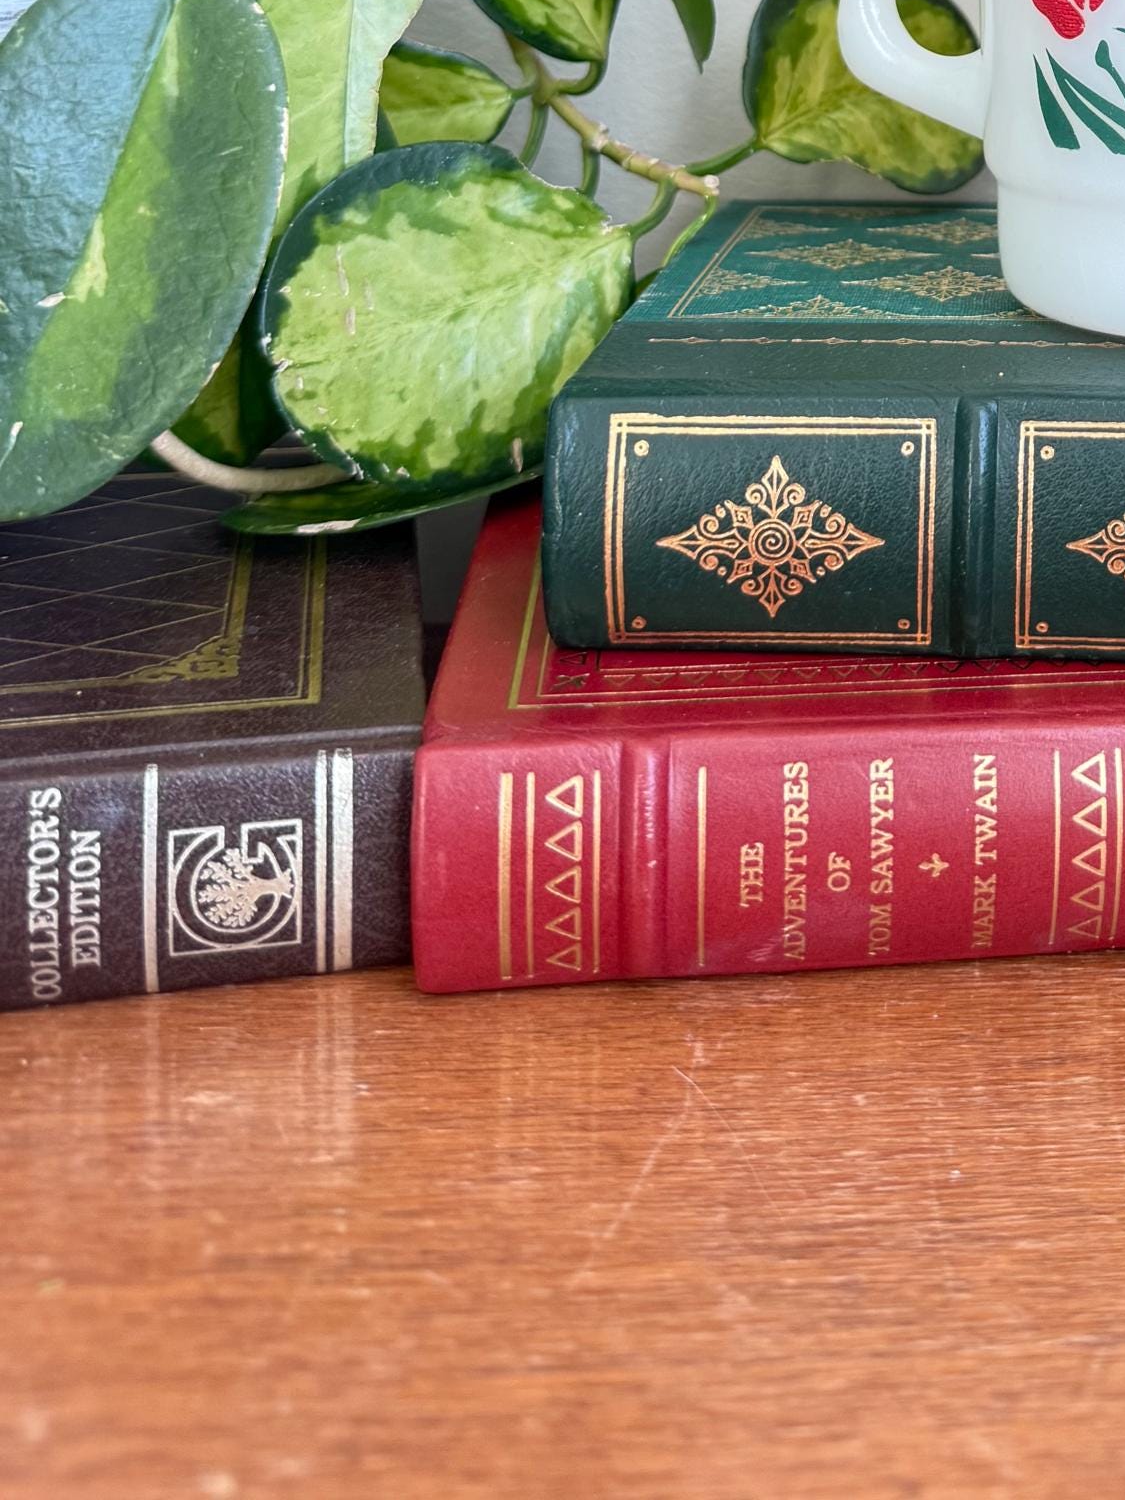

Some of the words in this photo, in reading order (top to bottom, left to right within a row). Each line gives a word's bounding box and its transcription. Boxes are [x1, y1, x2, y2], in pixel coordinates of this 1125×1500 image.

[783, 760, 809, 961] ADVENTURES
[869, 757, 894, 894] SAWYER
[973, 753, 997, 866] TWAIN
[28, 786, 62, 999] COLLECTOR'S
[69, 829, 101, 968] EDITION
[740, 841, 764, 908] THE
[827, 852, 851, 892] OF
[971, 873, 996, 950] MARK
[868, 903, 892, 956] TOM
